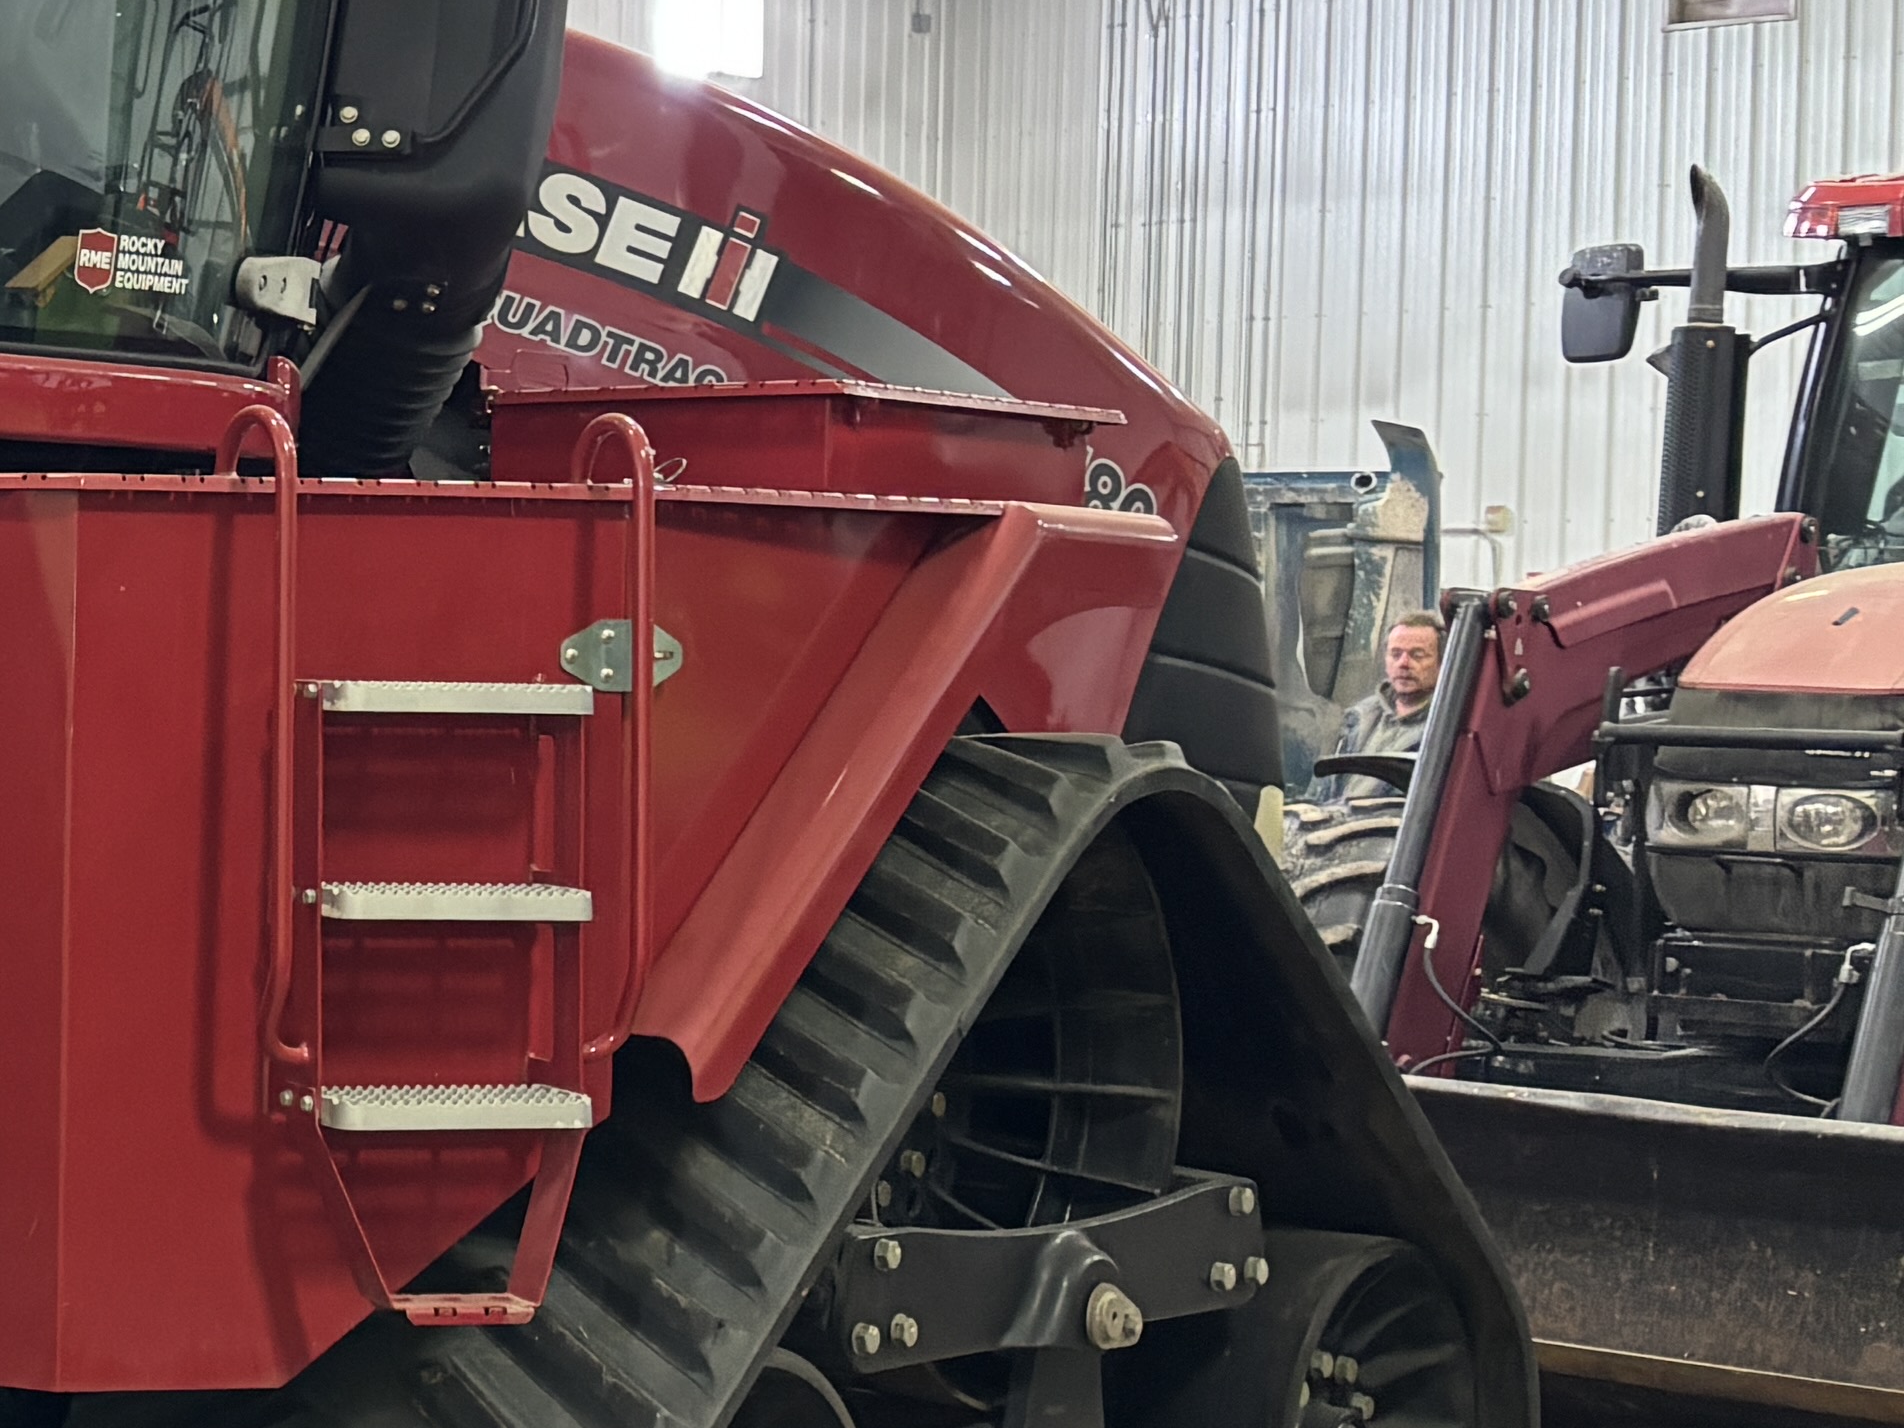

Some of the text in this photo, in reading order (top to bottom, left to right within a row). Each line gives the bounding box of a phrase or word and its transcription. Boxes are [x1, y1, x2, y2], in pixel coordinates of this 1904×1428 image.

[119, 234, 166, 256] ROCKY
[79, 248, 112, 270] RME
[117, 253, 184, 277] MOUNTAIN
[115, 270, 190, 295] EQUIPMENT
[486, 290, 728, 386] UADTRA
